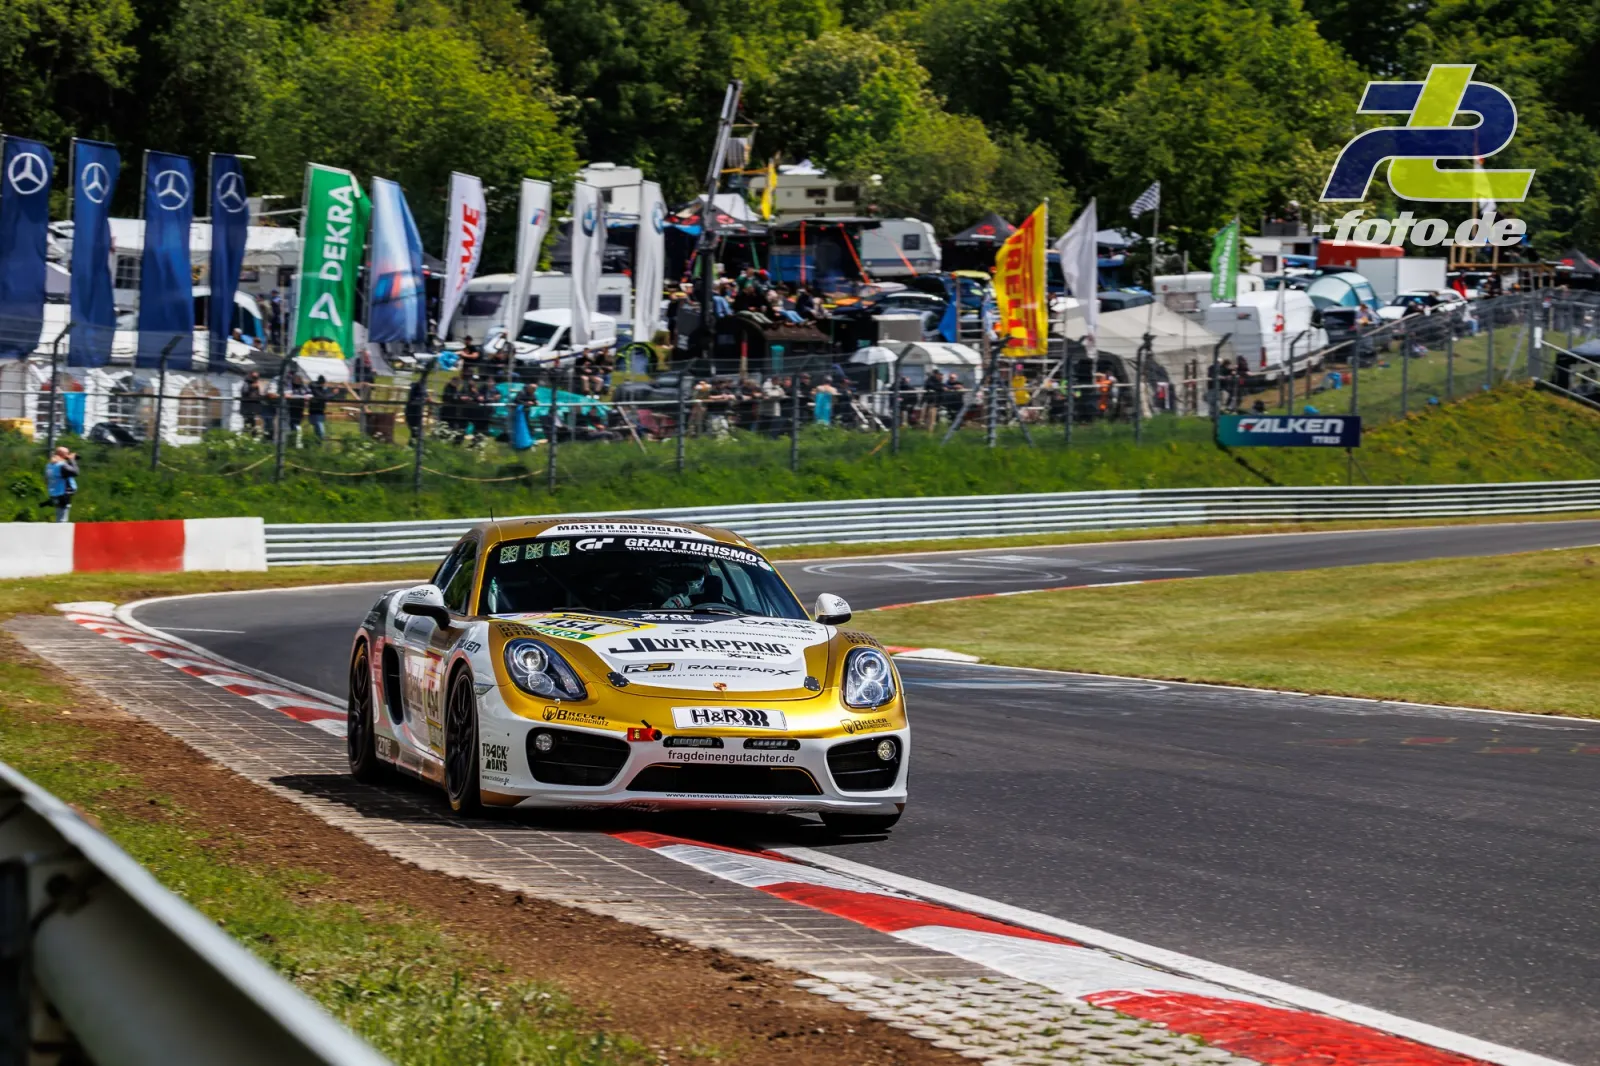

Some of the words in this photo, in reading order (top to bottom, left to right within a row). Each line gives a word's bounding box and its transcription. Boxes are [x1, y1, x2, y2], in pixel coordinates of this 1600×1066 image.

[319, 173, 361, 282] DEKRA
[1237, 418, 1345, 434] FALKEN
[619, 524, 692, 535] AUTOGLAS
[624, 538, 675, 549] GRAN
[680, 541, 759, 562] TURISMO
[672, 549, 708, 557] DRIVING
[709, 553, 758, 567] SIMULATOR
[538, 619, 605, 631] 454
[655, 638, 792, 655] WRAPPING
[690, 709, 740, 723] H&R
[482, 742, 507, 759] TRACK
[668, 750, 795, 763] fragdeinengutachter.de
